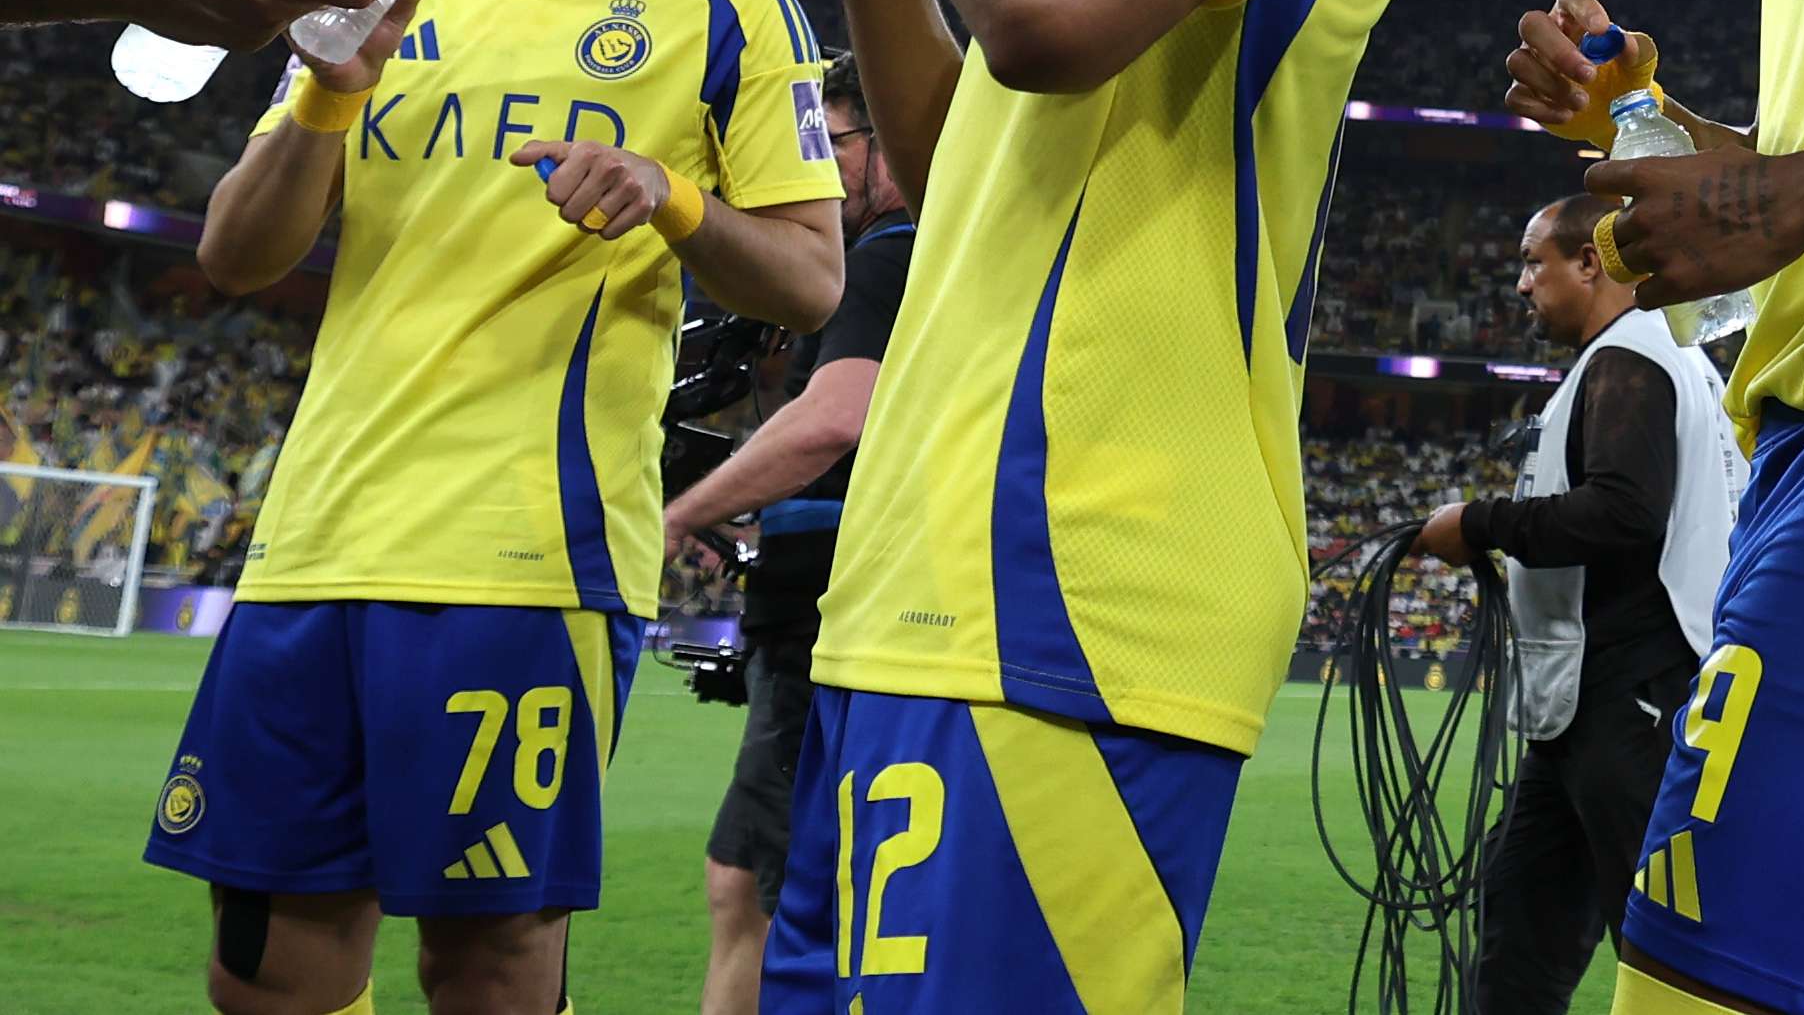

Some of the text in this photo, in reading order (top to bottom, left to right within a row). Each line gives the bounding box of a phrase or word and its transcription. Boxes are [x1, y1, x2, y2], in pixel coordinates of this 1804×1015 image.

[361, 92, 625, 160] KAFD
[799, 107, 825, 130] AF
[446, 686, 572, 815] 78
[1685, 644, 1763, 823] 9
[835, 762, 945, 978] 12
